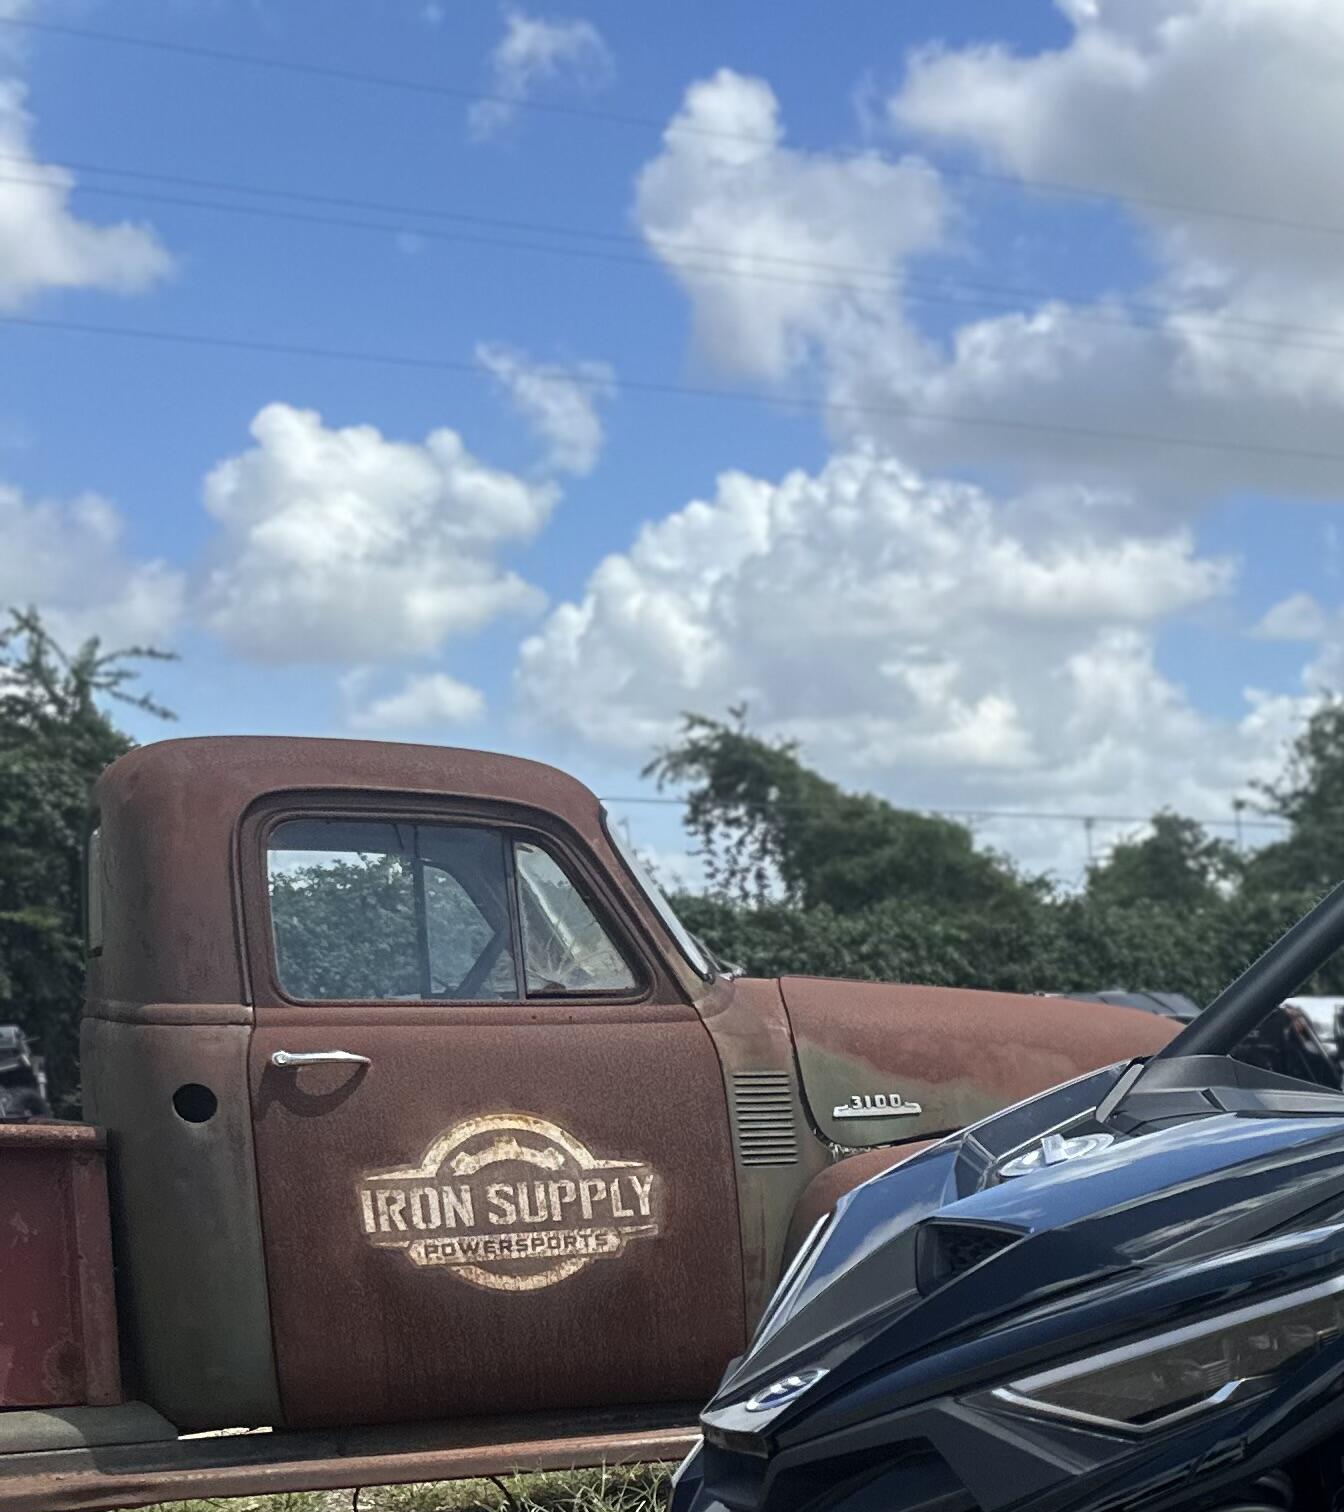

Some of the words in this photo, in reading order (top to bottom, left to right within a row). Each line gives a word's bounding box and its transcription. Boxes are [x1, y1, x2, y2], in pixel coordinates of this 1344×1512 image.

[851, 1093, 902, 1109] 3100
[361, 1185, 475, 1232] IRON
[487, 1174, 654, 1225] SUPPLY
[424, 1233, 609, 1257] POWERSPORTS
